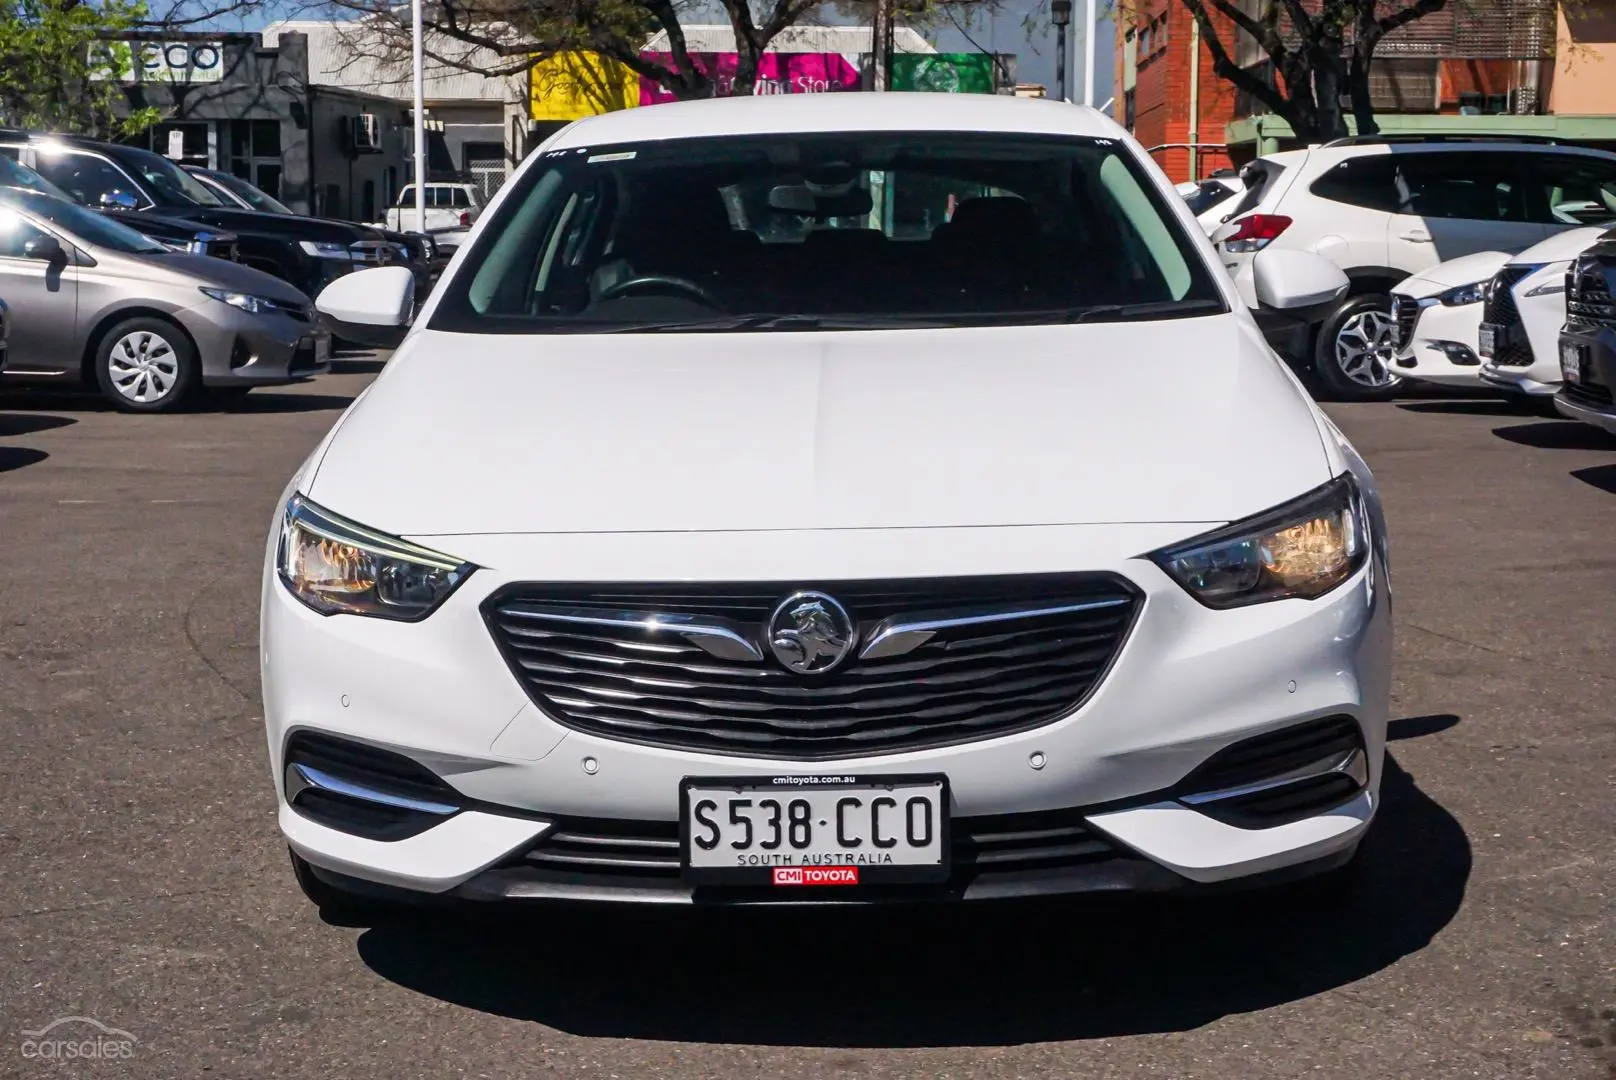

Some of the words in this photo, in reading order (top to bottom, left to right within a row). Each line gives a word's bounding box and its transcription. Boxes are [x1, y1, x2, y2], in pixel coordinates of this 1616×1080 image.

[772, 776, 856, 786] cmitoyota.com.au
[737, 854, 793, 866] SOUTH
[801, 853, 893, 865] AUSTRALIA
[804, 869, 856, 882] TOYOTA
